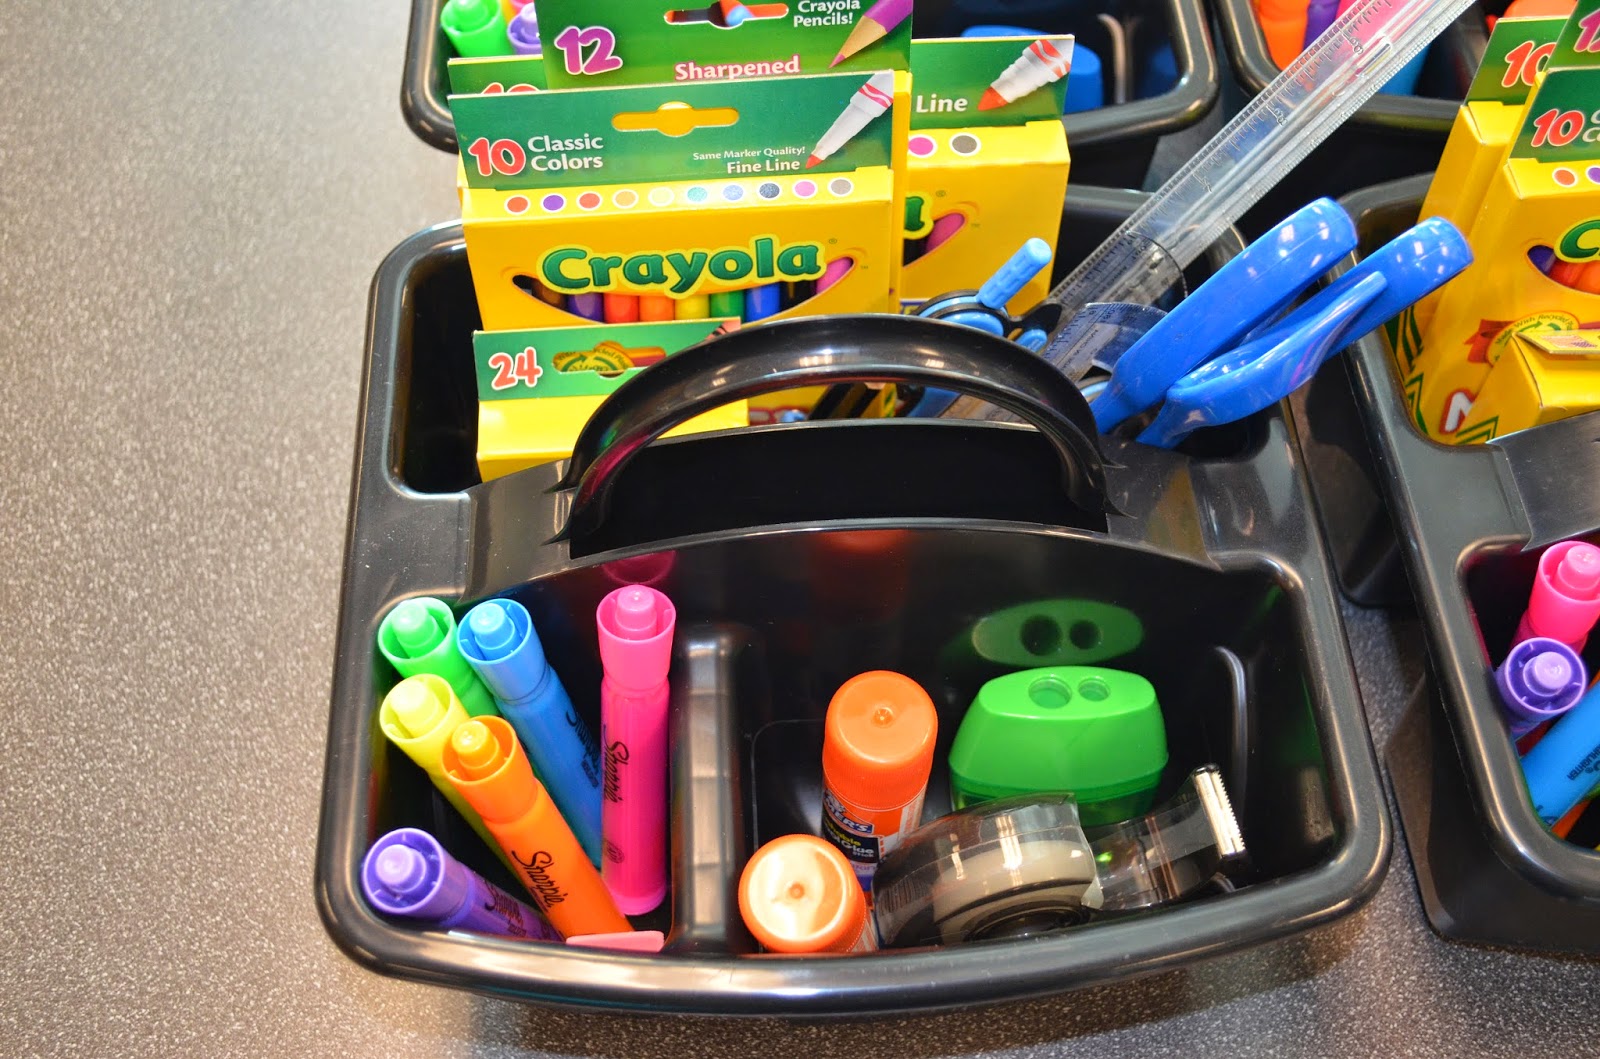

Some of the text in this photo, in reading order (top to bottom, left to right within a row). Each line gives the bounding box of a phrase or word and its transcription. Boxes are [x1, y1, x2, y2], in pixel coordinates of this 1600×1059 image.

[793, 12, 853, 27] Pencils!
[798, 0, 861, 14] Crayola
[553, 26, 623, 75] 12
[674, 55, 800, 80] Sharpened
[916, 94, 968, 113] Line
[1530, 108, 1585, 147] 10
[468, 133, 604, 177] 10 Classic
[530, 154, 604, 172] Colors
[692, 146, 806, 161] Same Marker Quality!
[727, 158, 801, 174] Fine Line
[539, 235, 824, 296] Crayola
[488, 346, 543, 391] 24
[603, 724, 629, 803] Sharpie
[826, 797, 870, 832] MER'S
[841, 840, 874, 855] Glue
[511, 850, 568, 908] Sharpie
